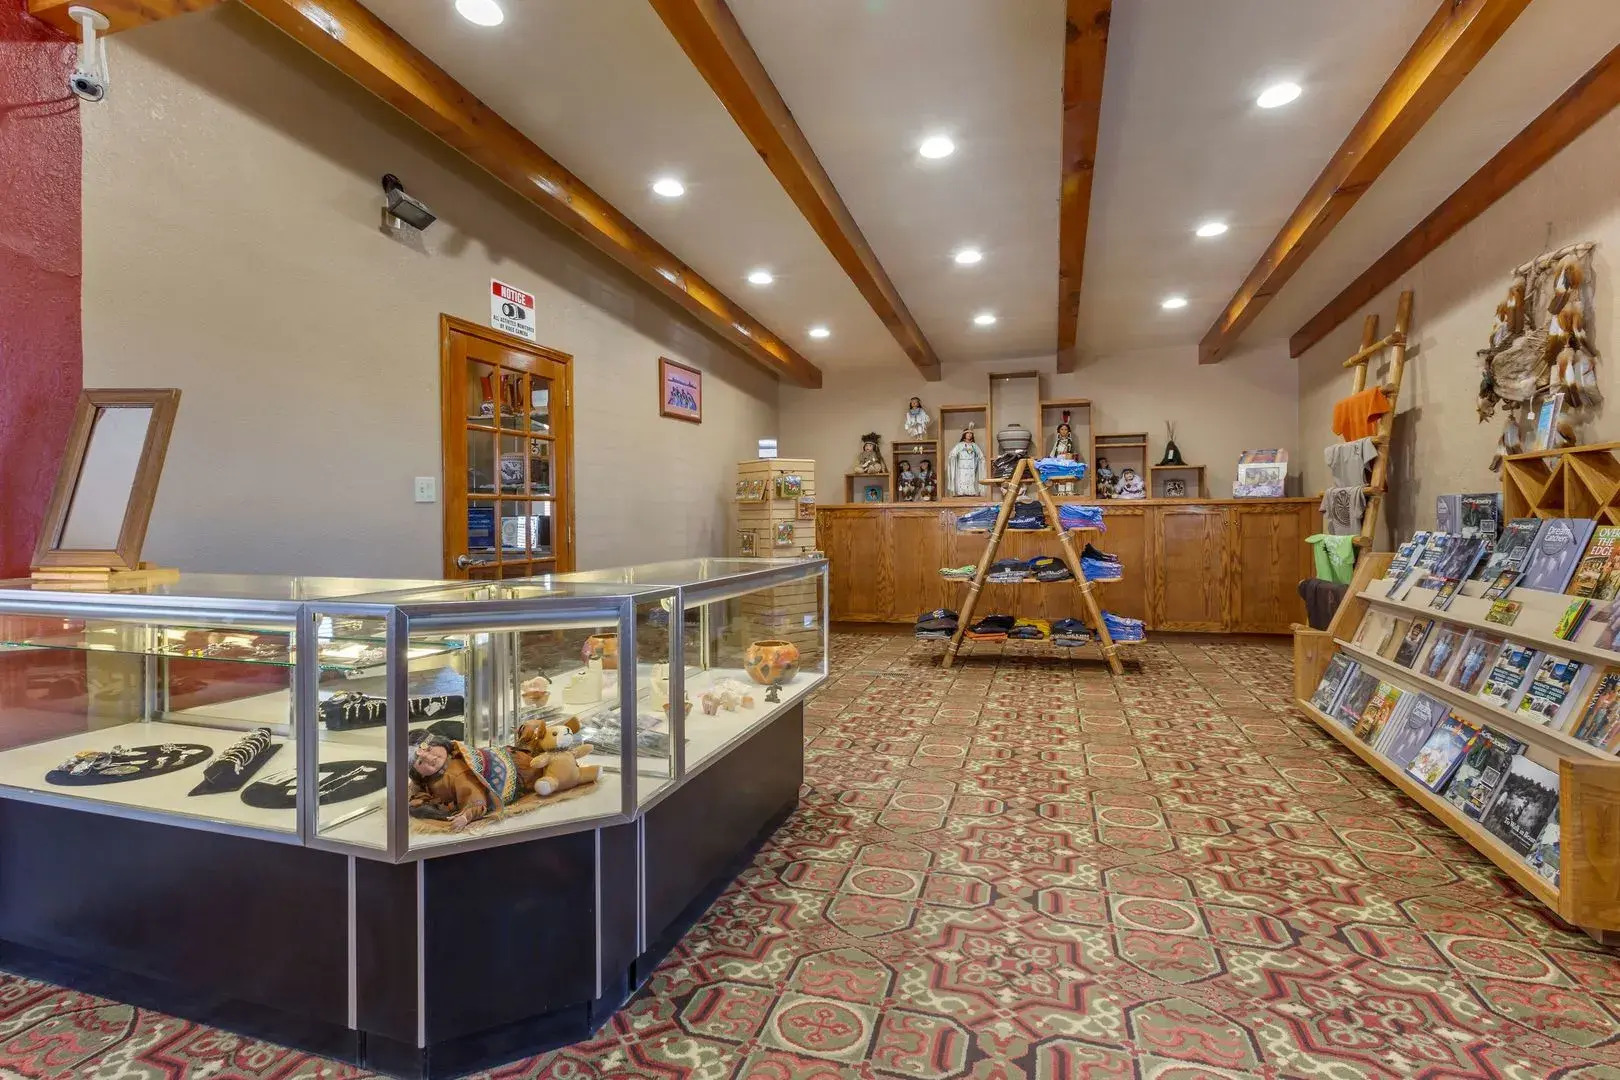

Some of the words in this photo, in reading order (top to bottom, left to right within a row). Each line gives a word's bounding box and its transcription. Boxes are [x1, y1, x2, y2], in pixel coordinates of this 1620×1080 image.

[501, 286, 526, 305] NOTICE
[1547, 526, 1571, 535] Dream
[1600, 528, 1620, 538] OVER
[1597, 537, 1616, 547] THE
[1590, 546, 1614, 556] EDGE
